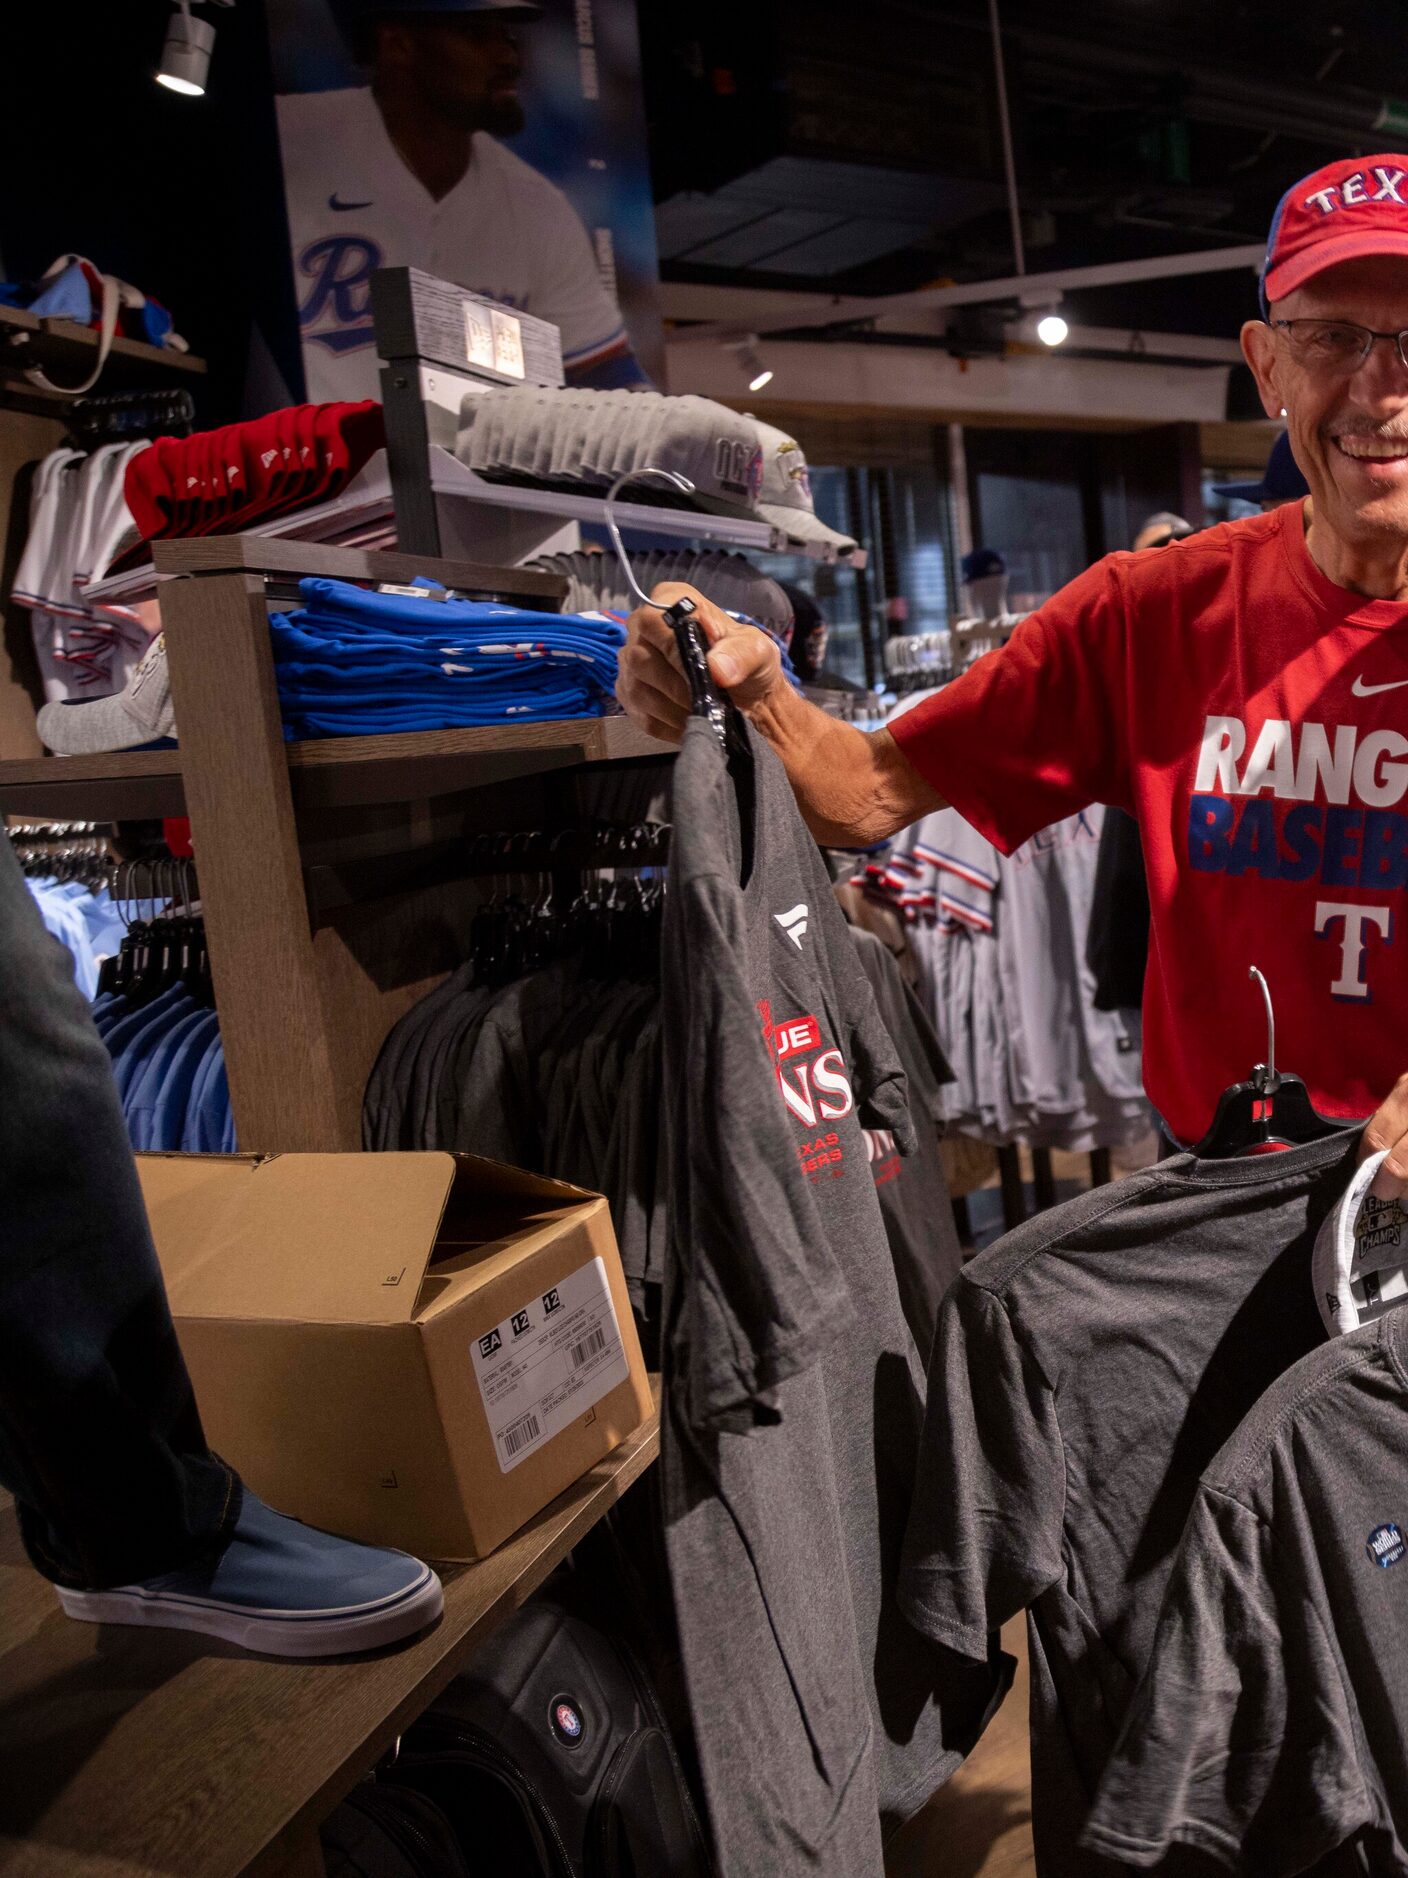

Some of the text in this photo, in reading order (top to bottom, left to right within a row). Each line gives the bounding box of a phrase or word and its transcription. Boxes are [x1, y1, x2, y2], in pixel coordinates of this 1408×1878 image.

[1314, 901, 1395, 1006] T
[1359, 1224, 1401, 1259] CHAMPS
[480, 1333, 500, 1355] EA
[513, 1314, 530, 1333] 12
[543, 1293, 560, 1310] 12
